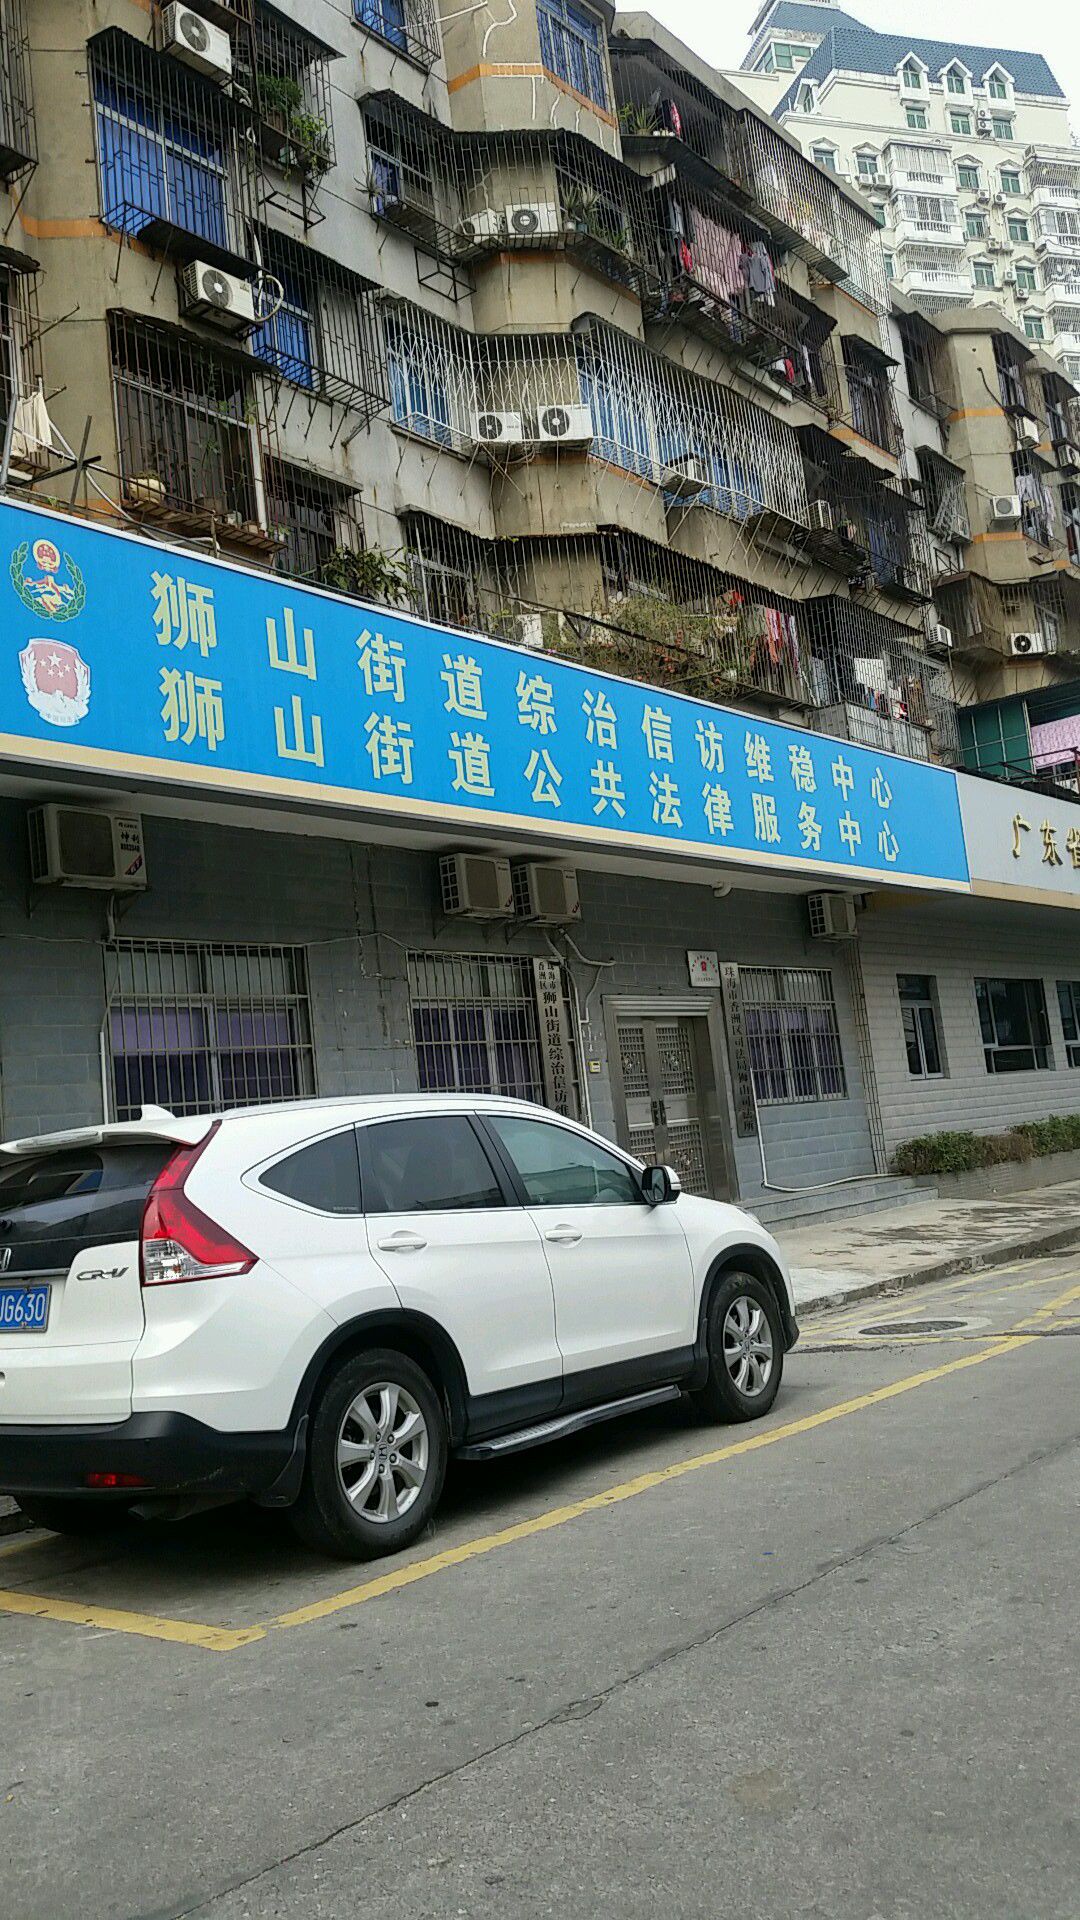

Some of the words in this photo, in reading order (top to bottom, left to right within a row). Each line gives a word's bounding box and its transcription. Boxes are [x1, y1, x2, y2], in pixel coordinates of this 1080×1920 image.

[150, 570, 894, 810] 狮山街道综治信访维稳中心
[158, 666, 900, 863] 狮山街道公共法律服务中心
[76, 1266, 129, 1281] CR-V
